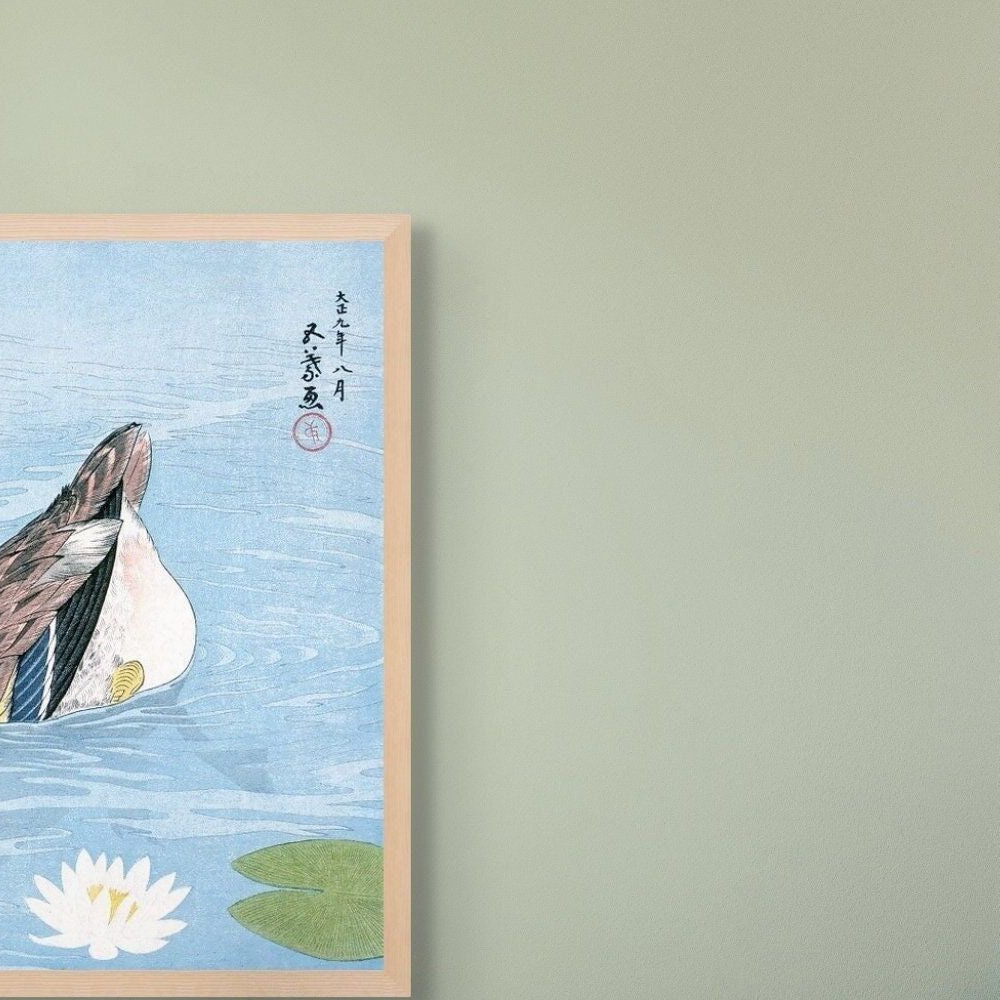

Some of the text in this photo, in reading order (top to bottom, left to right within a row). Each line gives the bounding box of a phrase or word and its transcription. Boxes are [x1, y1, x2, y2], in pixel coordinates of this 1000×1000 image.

[332, 290, 353, 402] 大正九年八月
